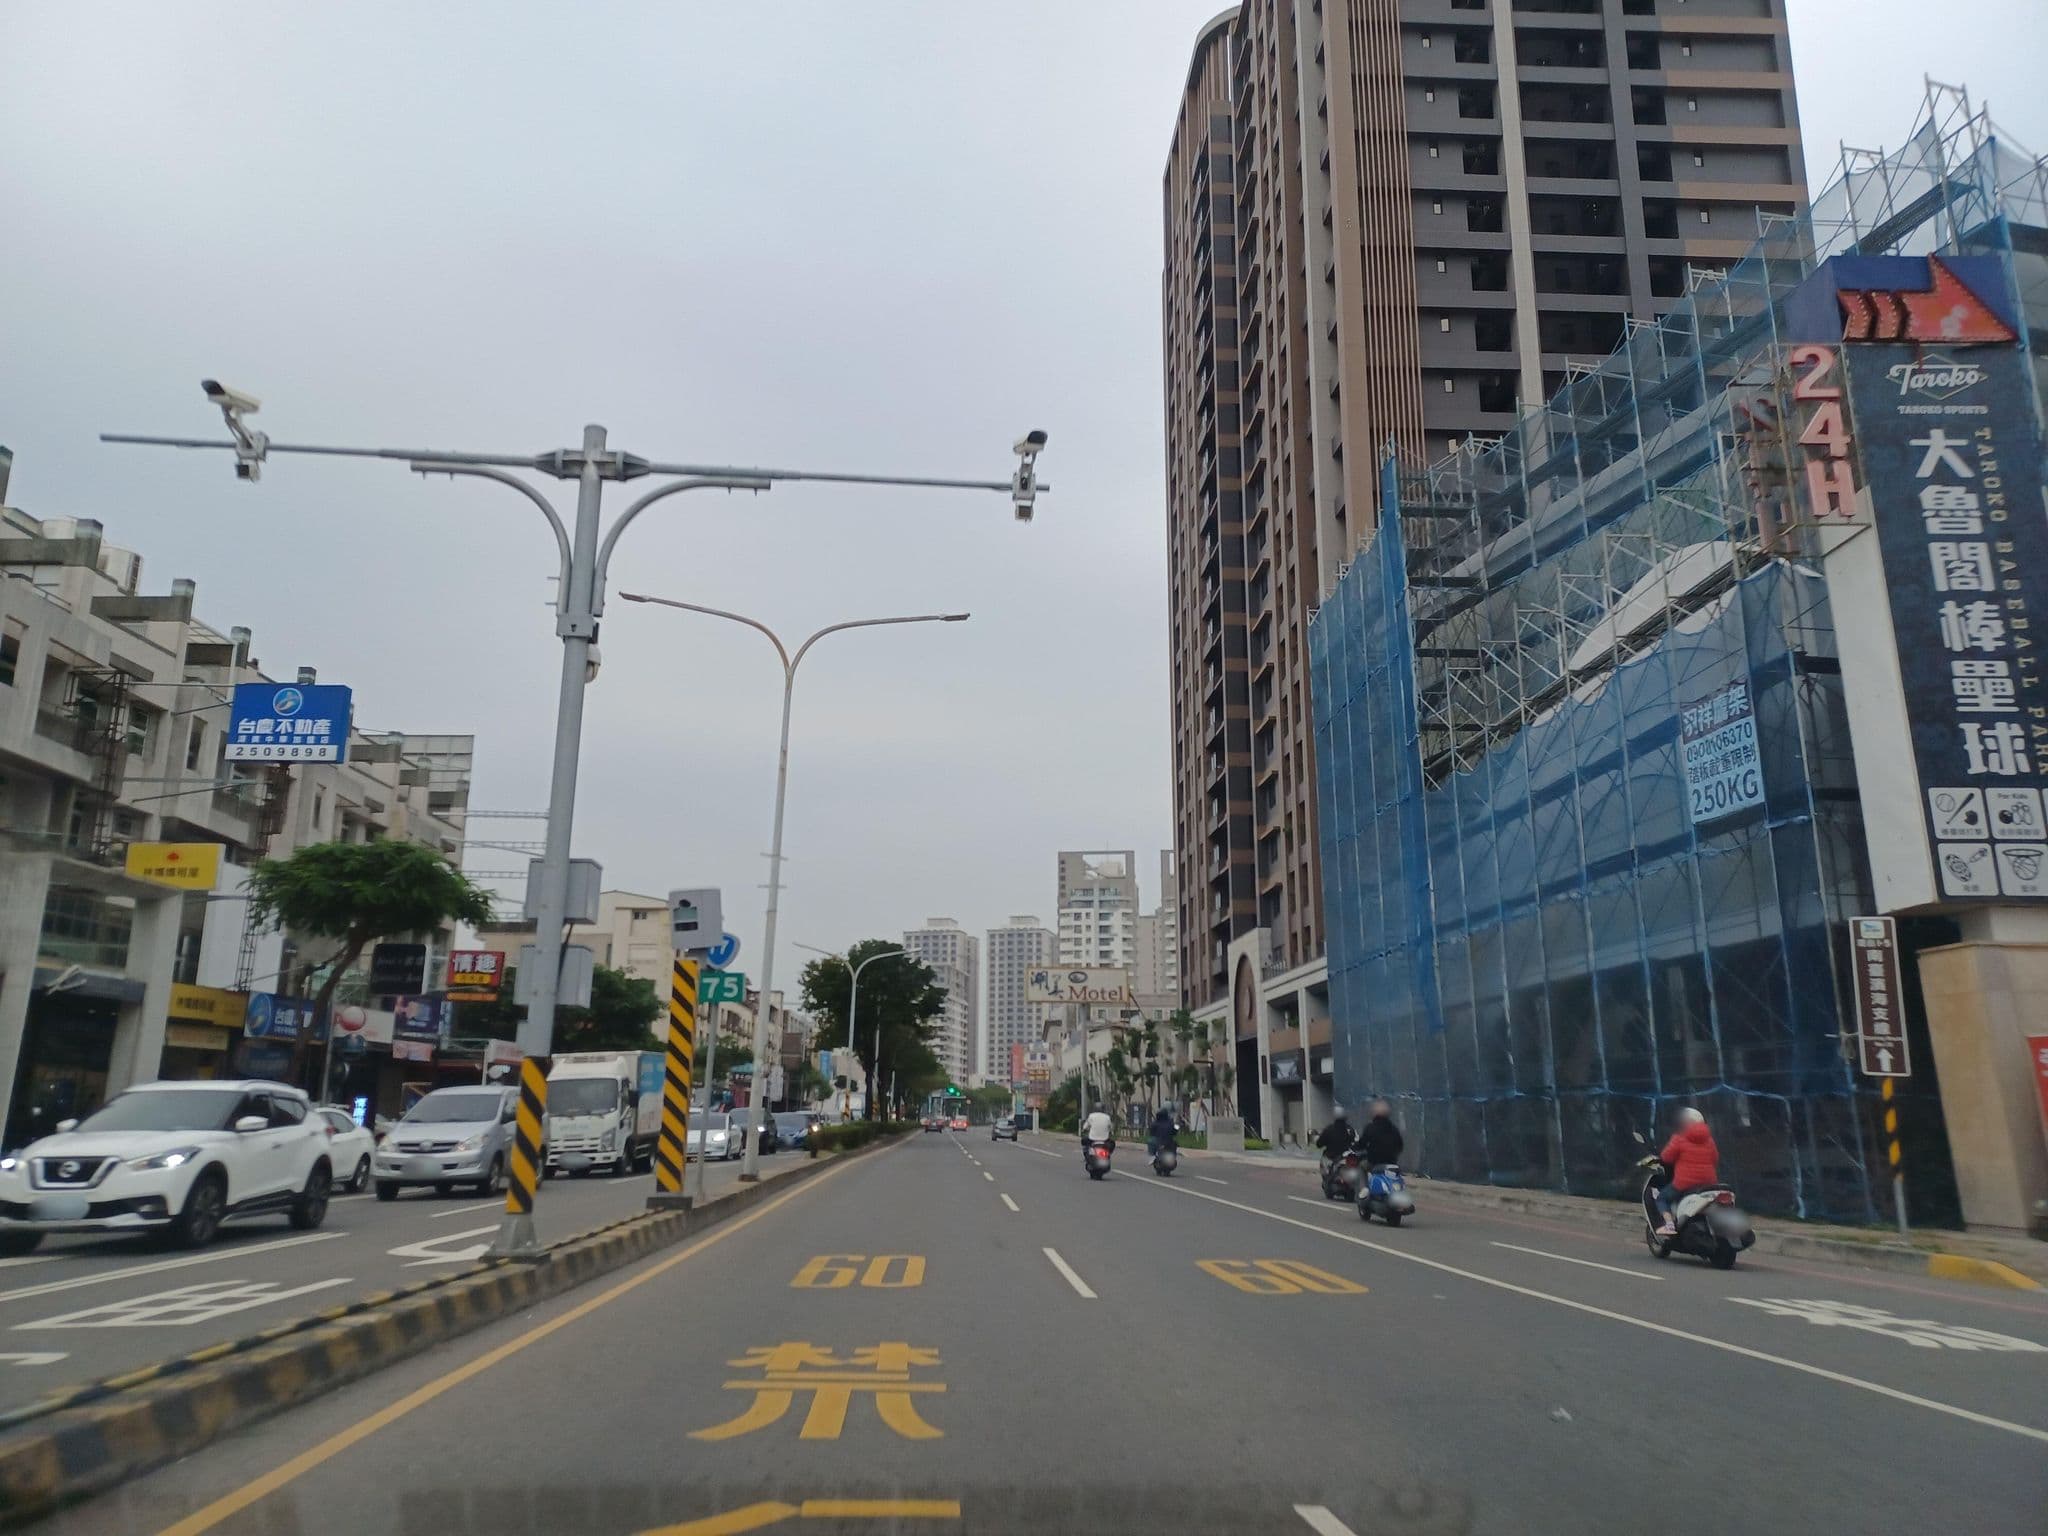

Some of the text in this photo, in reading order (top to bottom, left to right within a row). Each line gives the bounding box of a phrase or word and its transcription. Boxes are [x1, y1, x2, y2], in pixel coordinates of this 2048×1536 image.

[1888, 363, 1981, 396] Taroko
[1896, 405, 1989, 415] TAROKO SPORTS
[1789, 345, 1856, 517] 24H
[1909, 428, 2031, 777] 大魯閣棒壘球
[238, 717, 332, 735] 台慶不動產
[236, 747, 327, 757] 2509898
[1692, 768, 1759, 816] 250KG
[702, 976, 739, 1000] 75
[1069, 985, 1123, 1001] Motel
[789, 1254, 926, 1289] 60
[1194, 1259, 1370, 1294] 60
[686, 1341, 948, 1442] 禁
